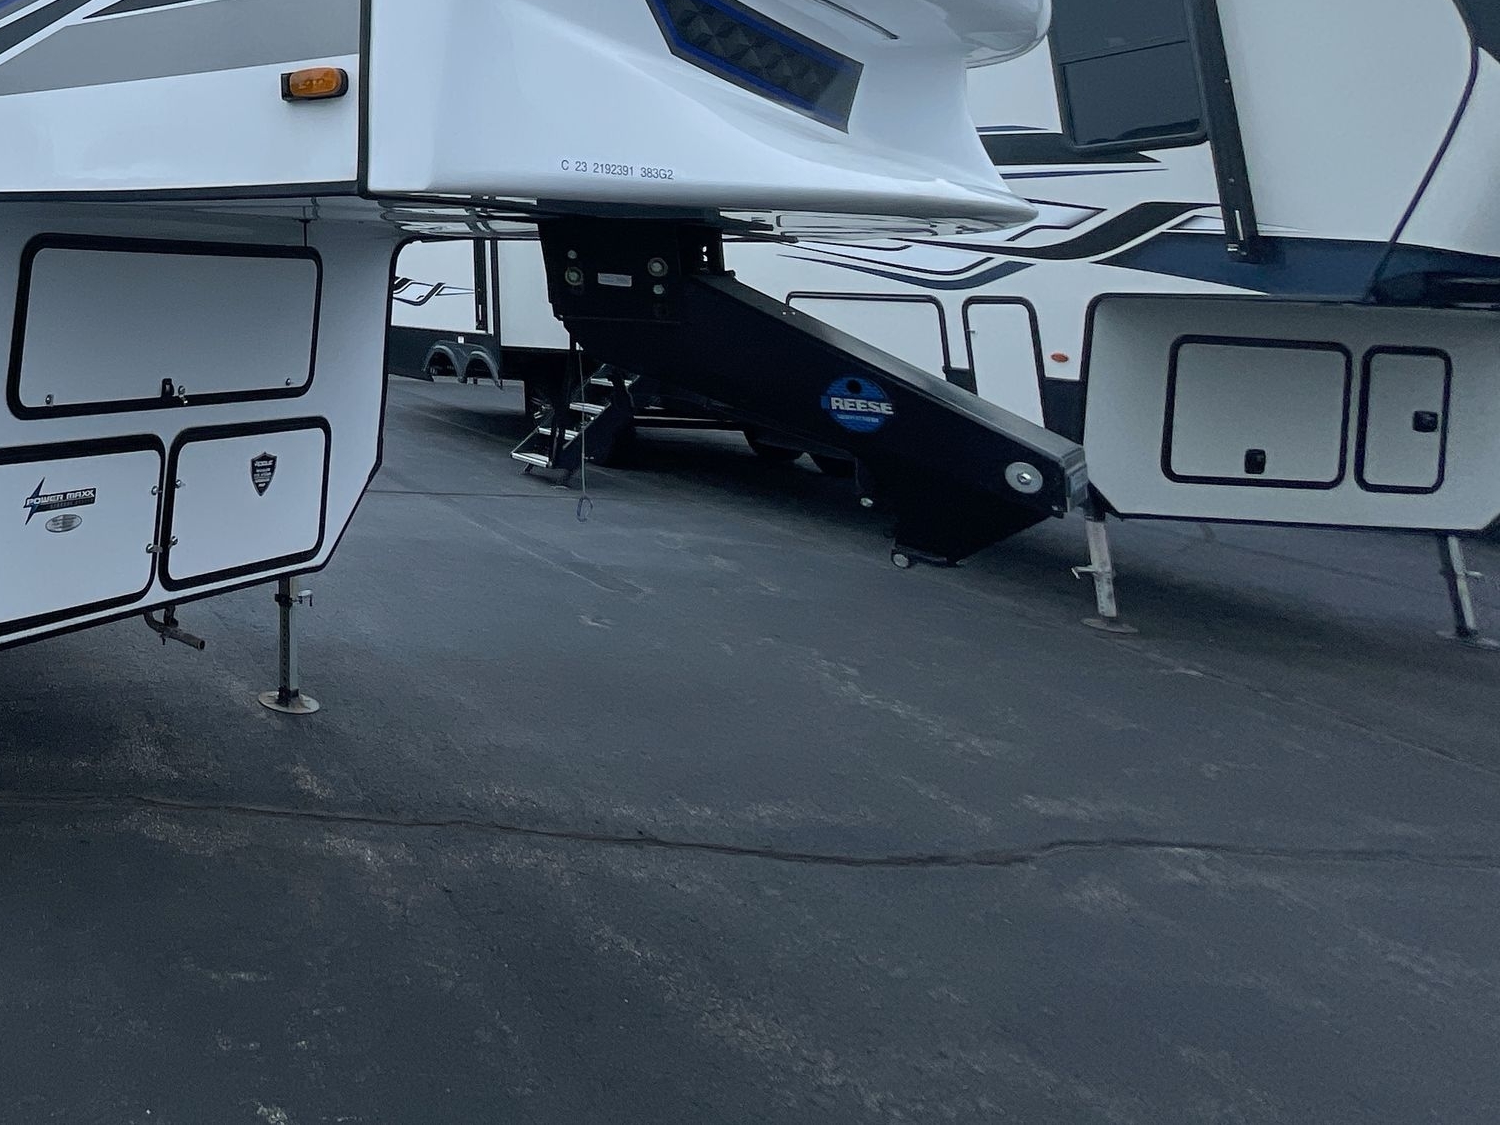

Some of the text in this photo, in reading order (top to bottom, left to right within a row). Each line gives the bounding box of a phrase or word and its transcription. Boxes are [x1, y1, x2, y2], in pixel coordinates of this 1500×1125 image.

[561, 159, 675, 181] C 23 2192391 383G2
[830, 396, 895, 415] REESE
[26, 494, 64, 506] POWER
[66, 489, 95, 500] MAXX
